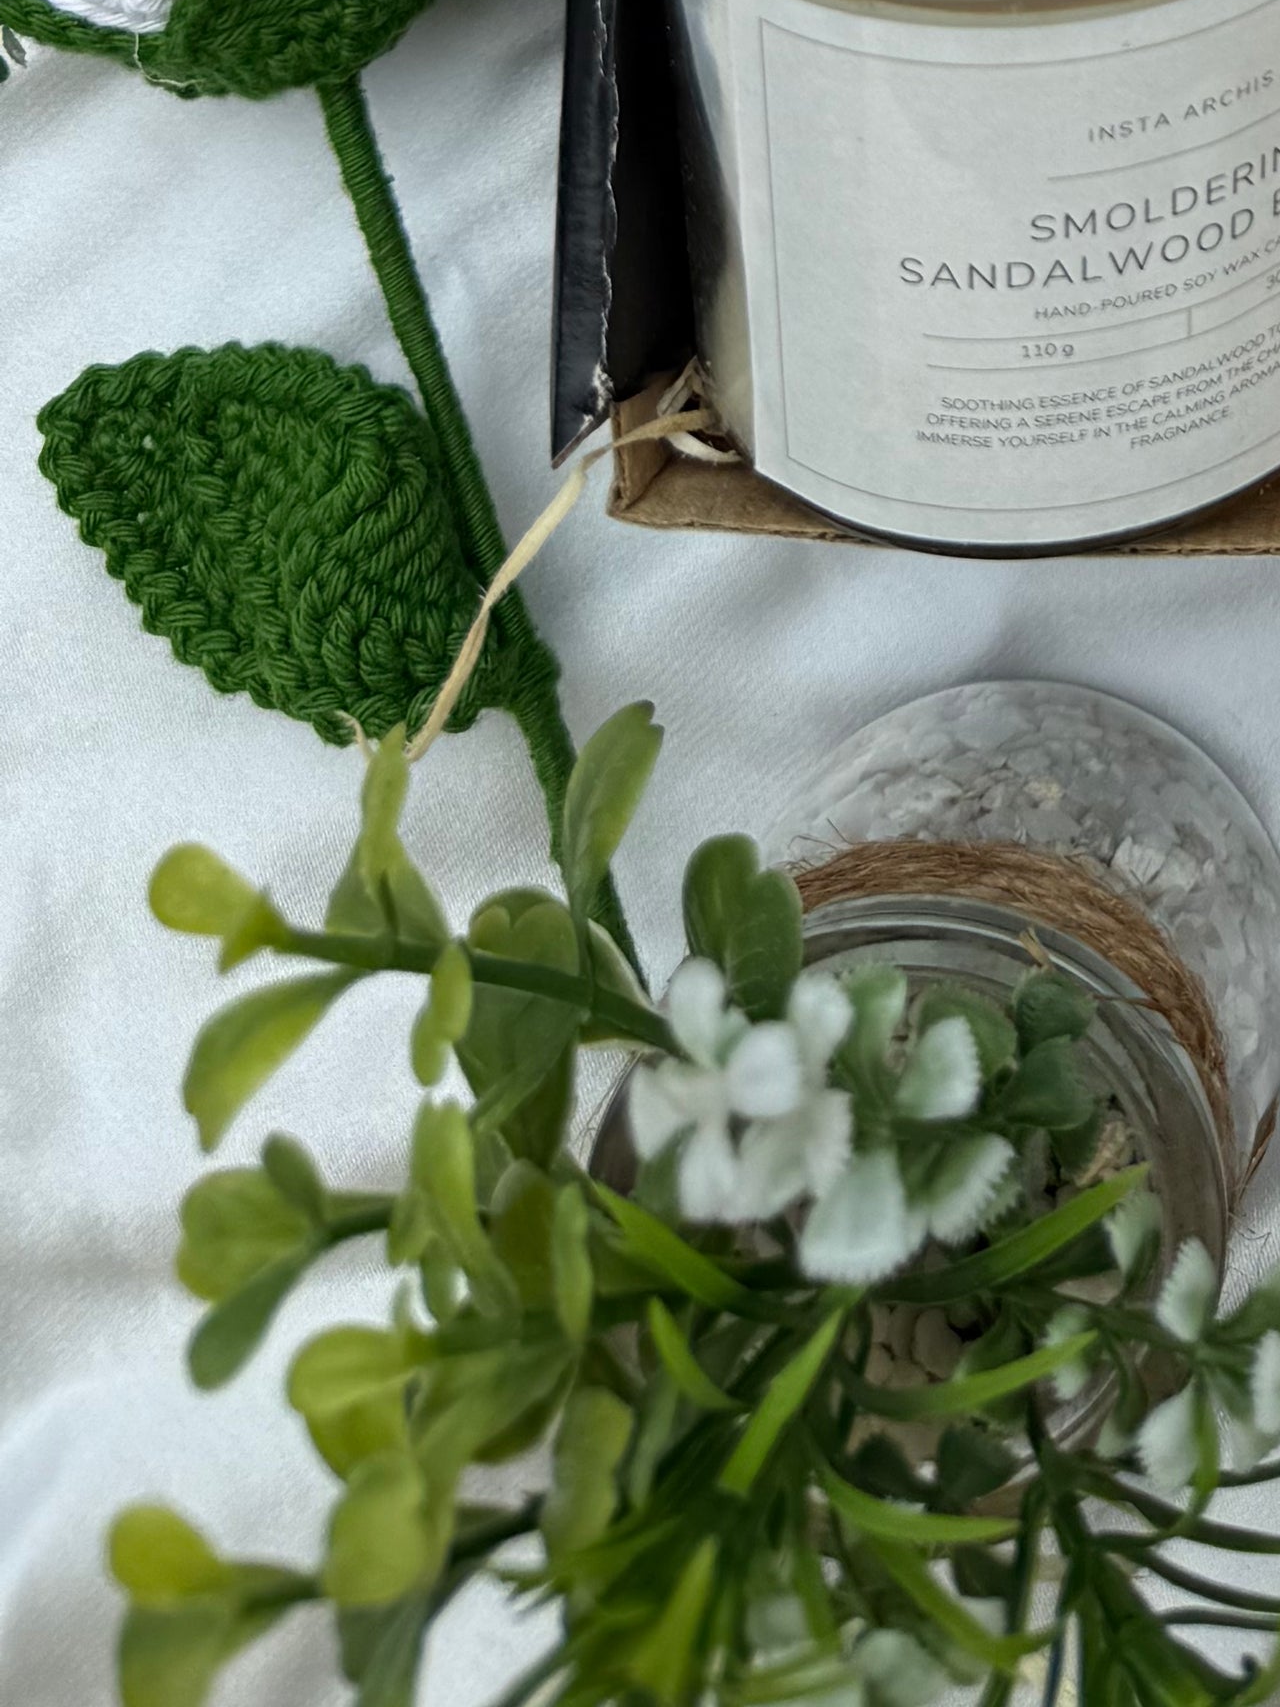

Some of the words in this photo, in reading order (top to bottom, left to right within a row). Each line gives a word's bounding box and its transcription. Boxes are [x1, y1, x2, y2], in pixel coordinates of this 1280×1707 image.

[1088, 110, 1172, 144] INSTA
[1183, 68, 1276, 121] ARCHIS
[900, 206, 1256, 291] SANDALWOOD
[1033, 281, 1178, 322] HAND-POURED
[1183, 269, 1218, 293] SOY
[1222, 247, 1262, 276] WAX
[1021, 342, 1058, 360] 110
